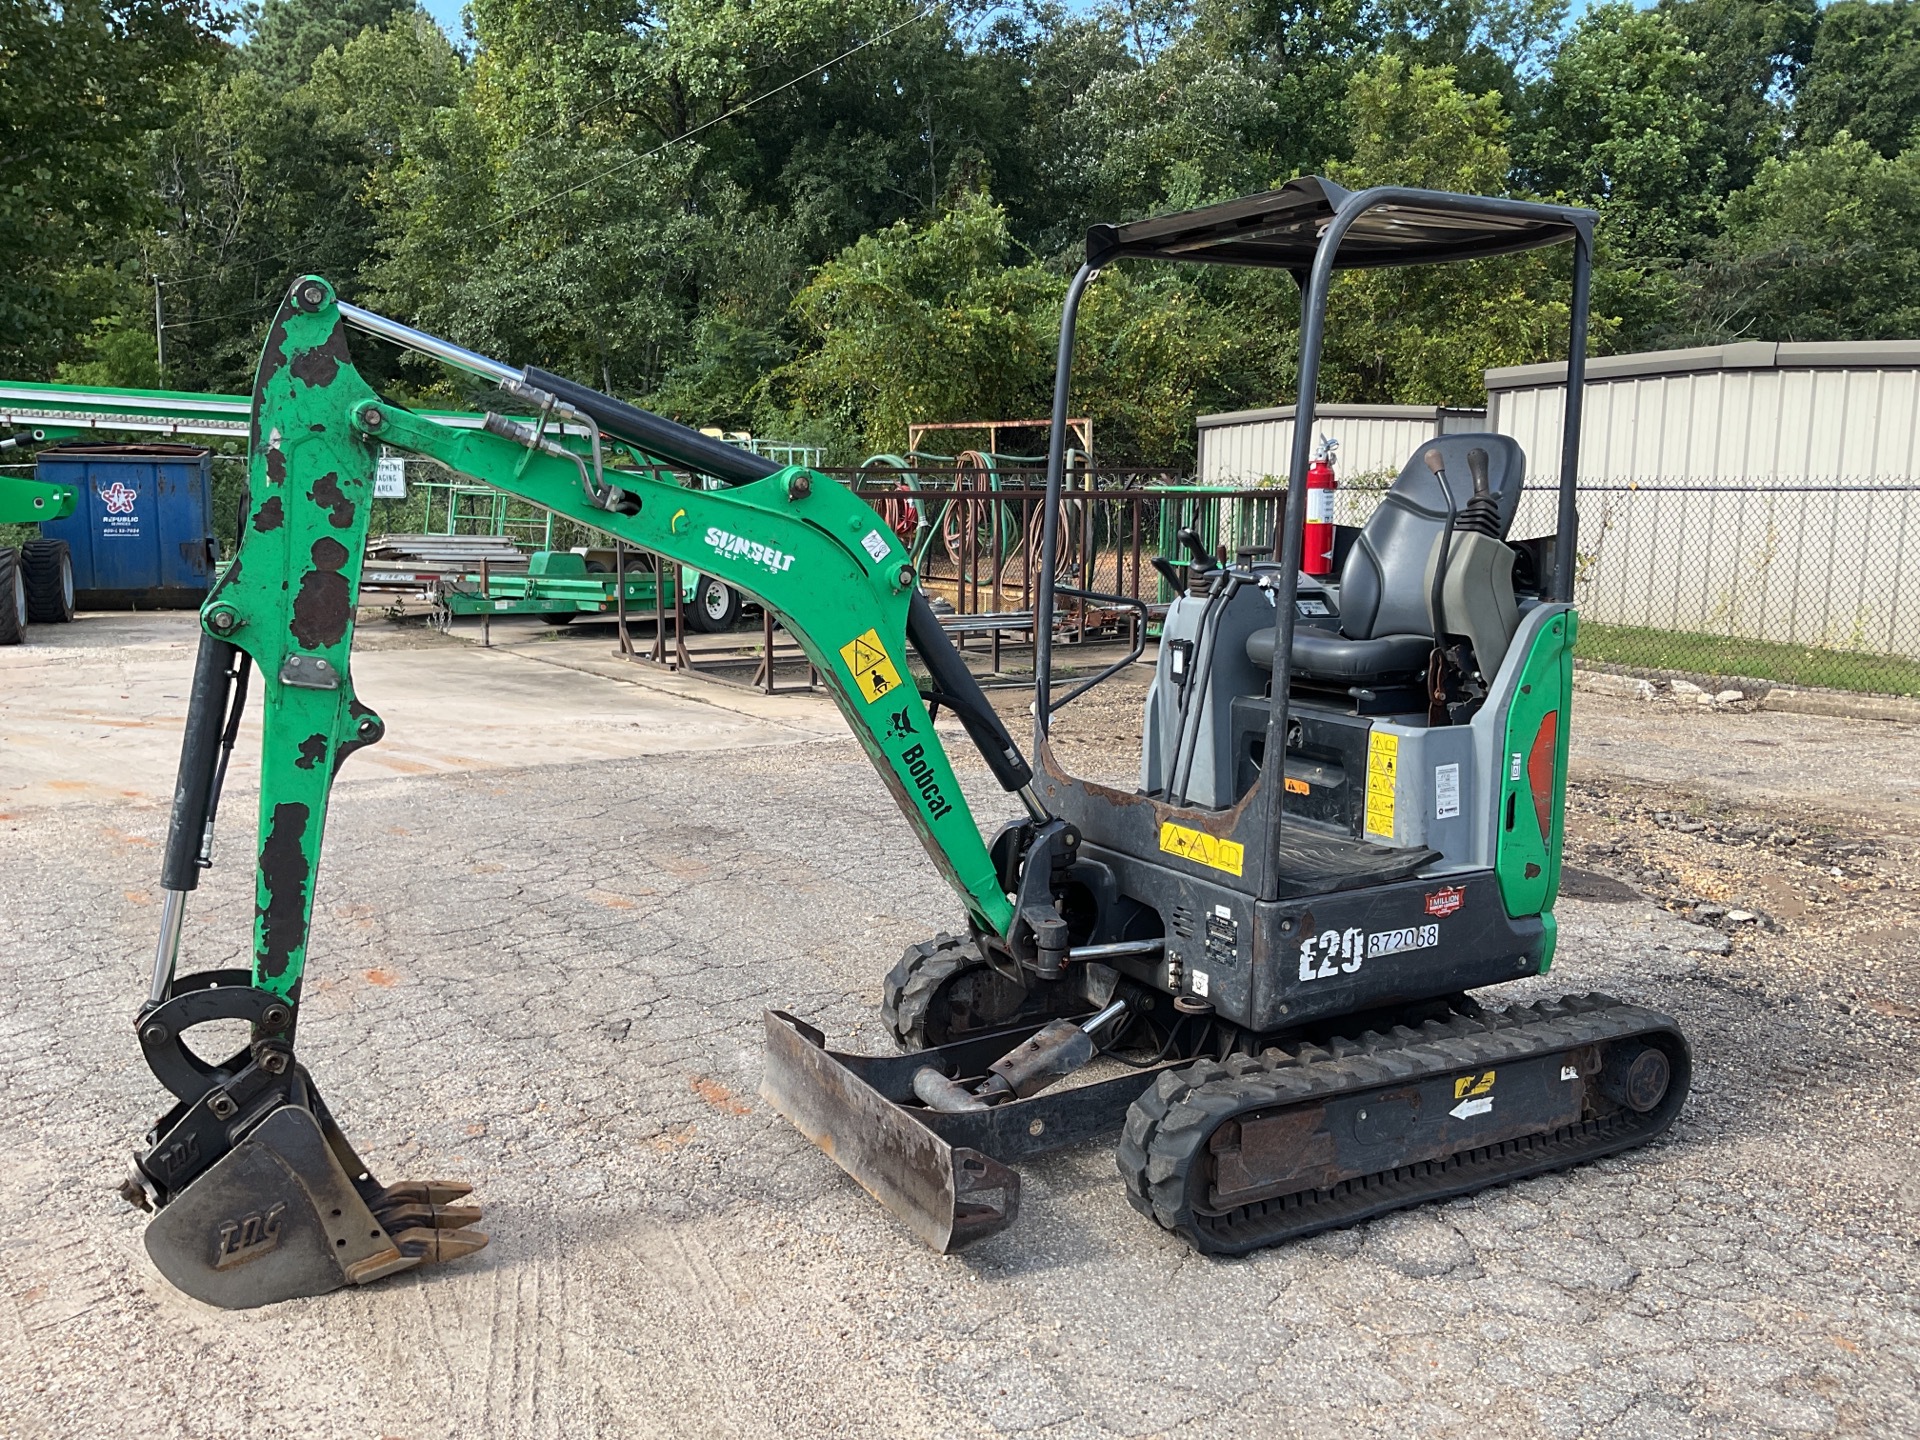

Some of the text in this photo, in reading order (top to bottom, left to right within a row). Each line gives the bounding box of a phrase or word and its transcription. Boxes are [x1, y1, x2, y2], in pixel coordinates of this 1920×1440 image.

[377, 484, 393, 492] AREA
[901, 742, 953, 821] Bobcat
[1433, 894, 1460, 906] MILLION
[1369, 925, 1437, 956] 872068
